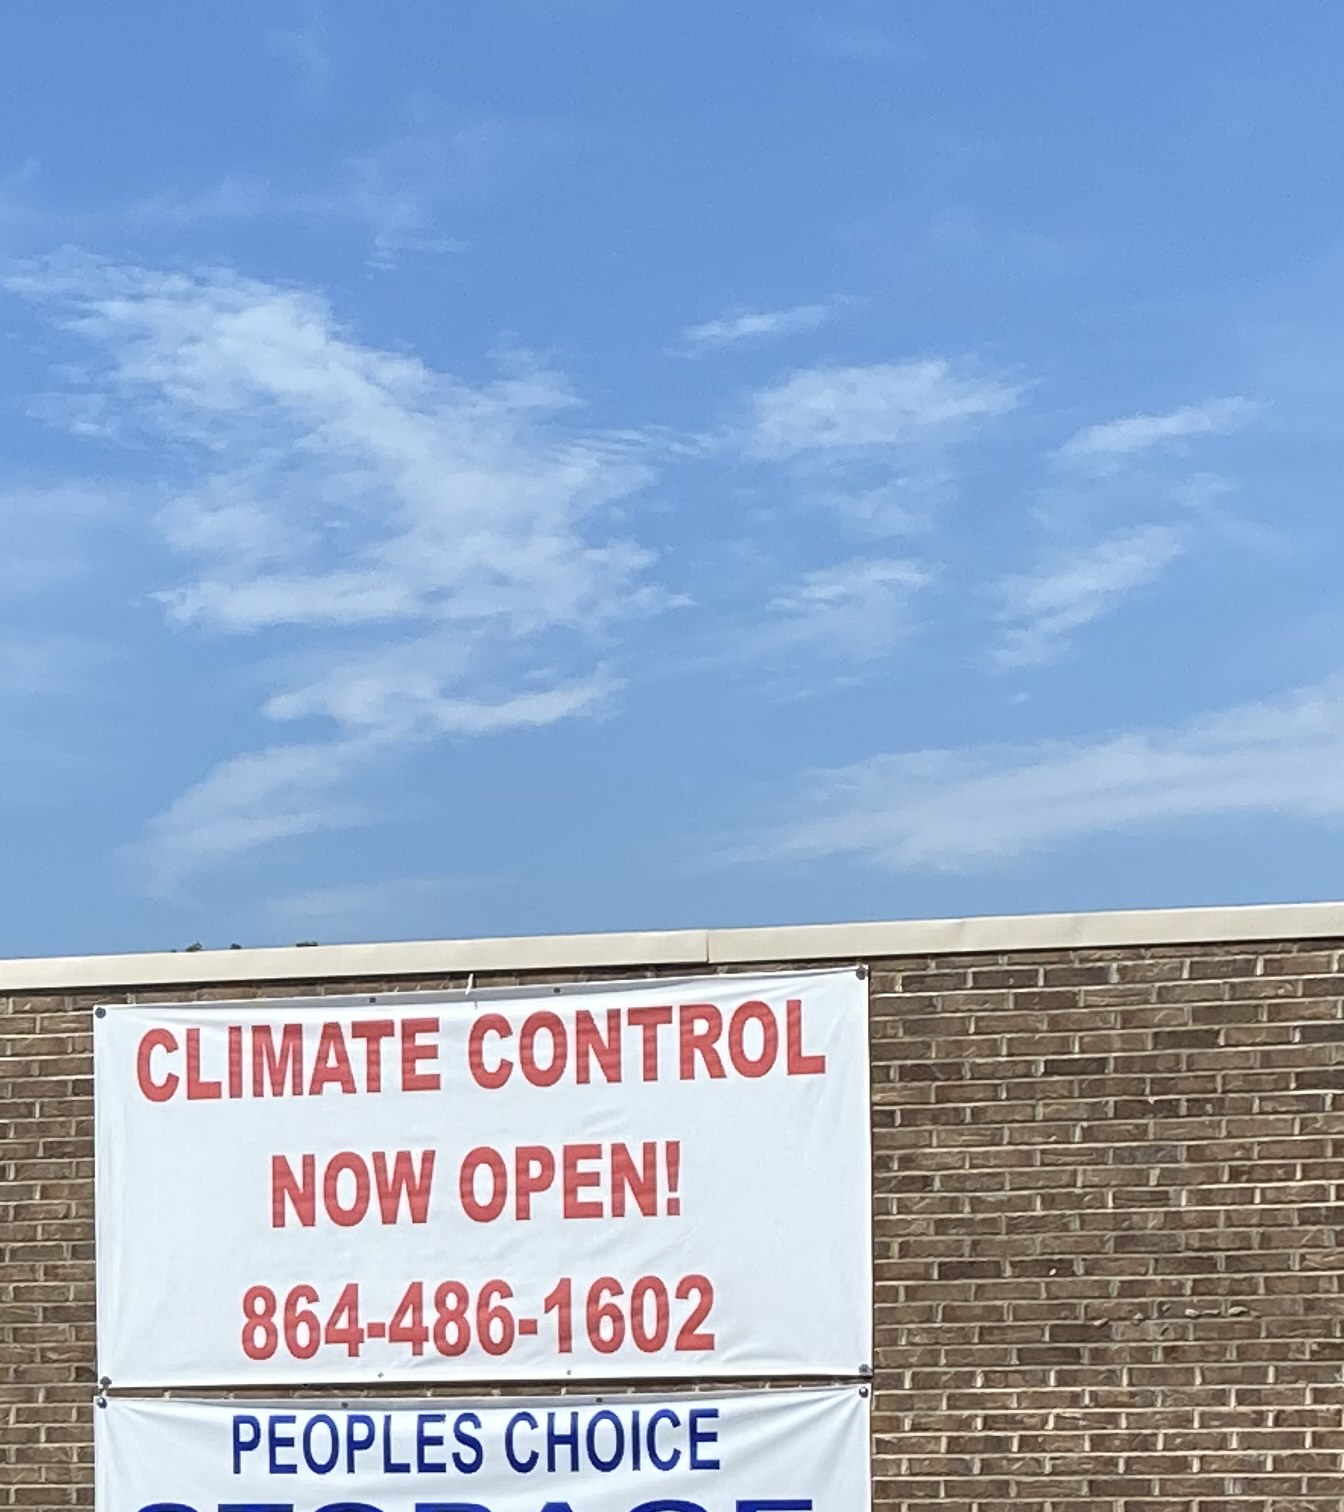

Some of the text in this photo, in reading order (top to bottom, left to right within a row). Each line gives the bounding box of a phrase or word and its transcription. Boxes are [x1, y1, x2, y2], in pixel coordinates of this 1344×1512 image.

[136, 998, 826, 1102] CLIMATE CONTROL
[271, 1140, 681, 1228] NOW OPEN!
[241, 1275, 716, 1361] 864-486-1602
[231, 1407, 721, 1475] PEOPLES CHOICE
